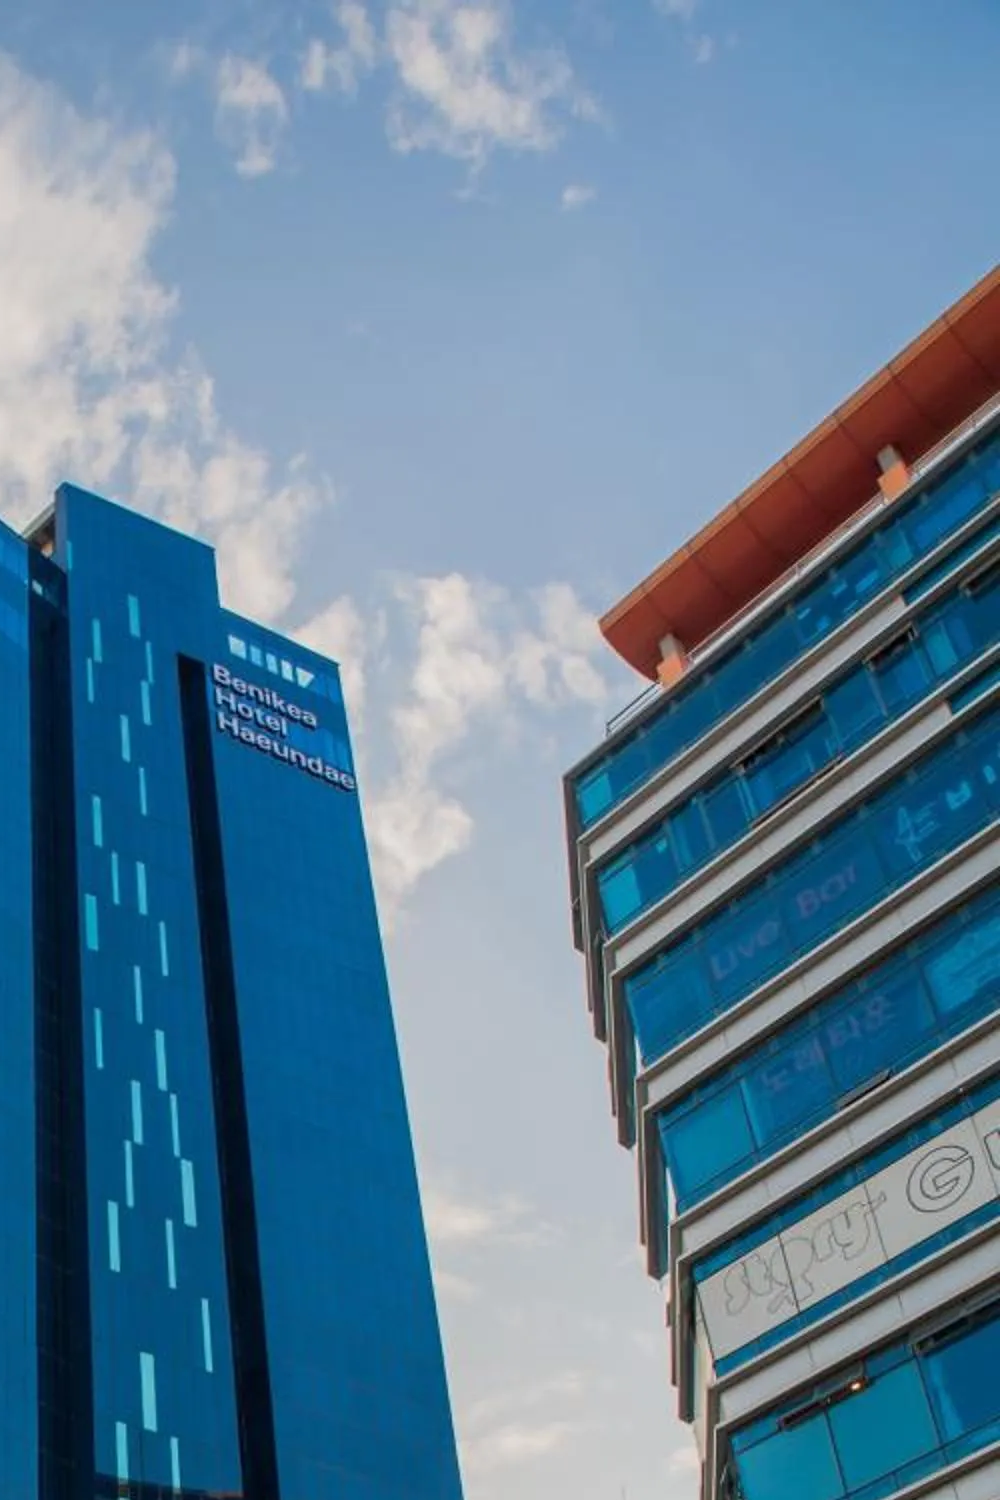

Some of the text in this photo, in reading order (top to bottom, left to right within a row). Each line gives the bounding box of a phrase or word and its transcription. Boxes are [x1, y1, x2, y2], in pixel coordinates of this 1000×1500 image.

[213, 663, 318, 728] Benikea
[214, 687, 288, 736] Hotel
[217, 711, 356, 789] Haeundae
